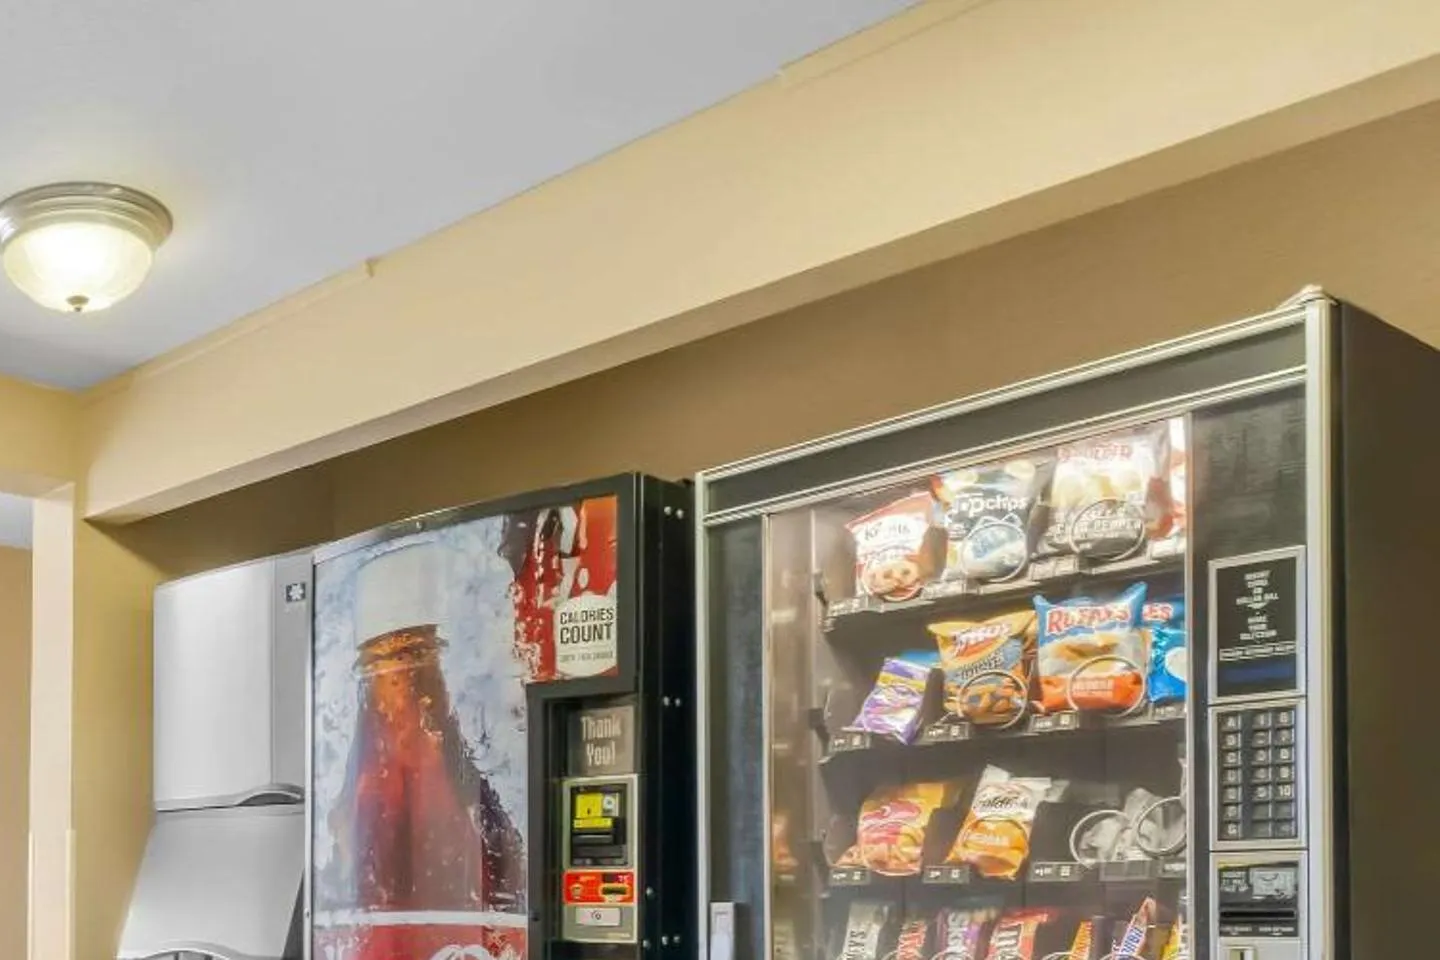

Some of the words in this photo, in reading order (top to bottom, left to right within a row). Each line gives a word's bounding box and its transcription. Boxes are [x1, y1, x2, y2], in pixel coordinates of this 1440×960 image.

[560, 608, 614, 625] CALORIES
[560, 622, 615, 645] COUNT
[581, 714, 621, 741] Thank
[586, 741, 616, 766] You!
